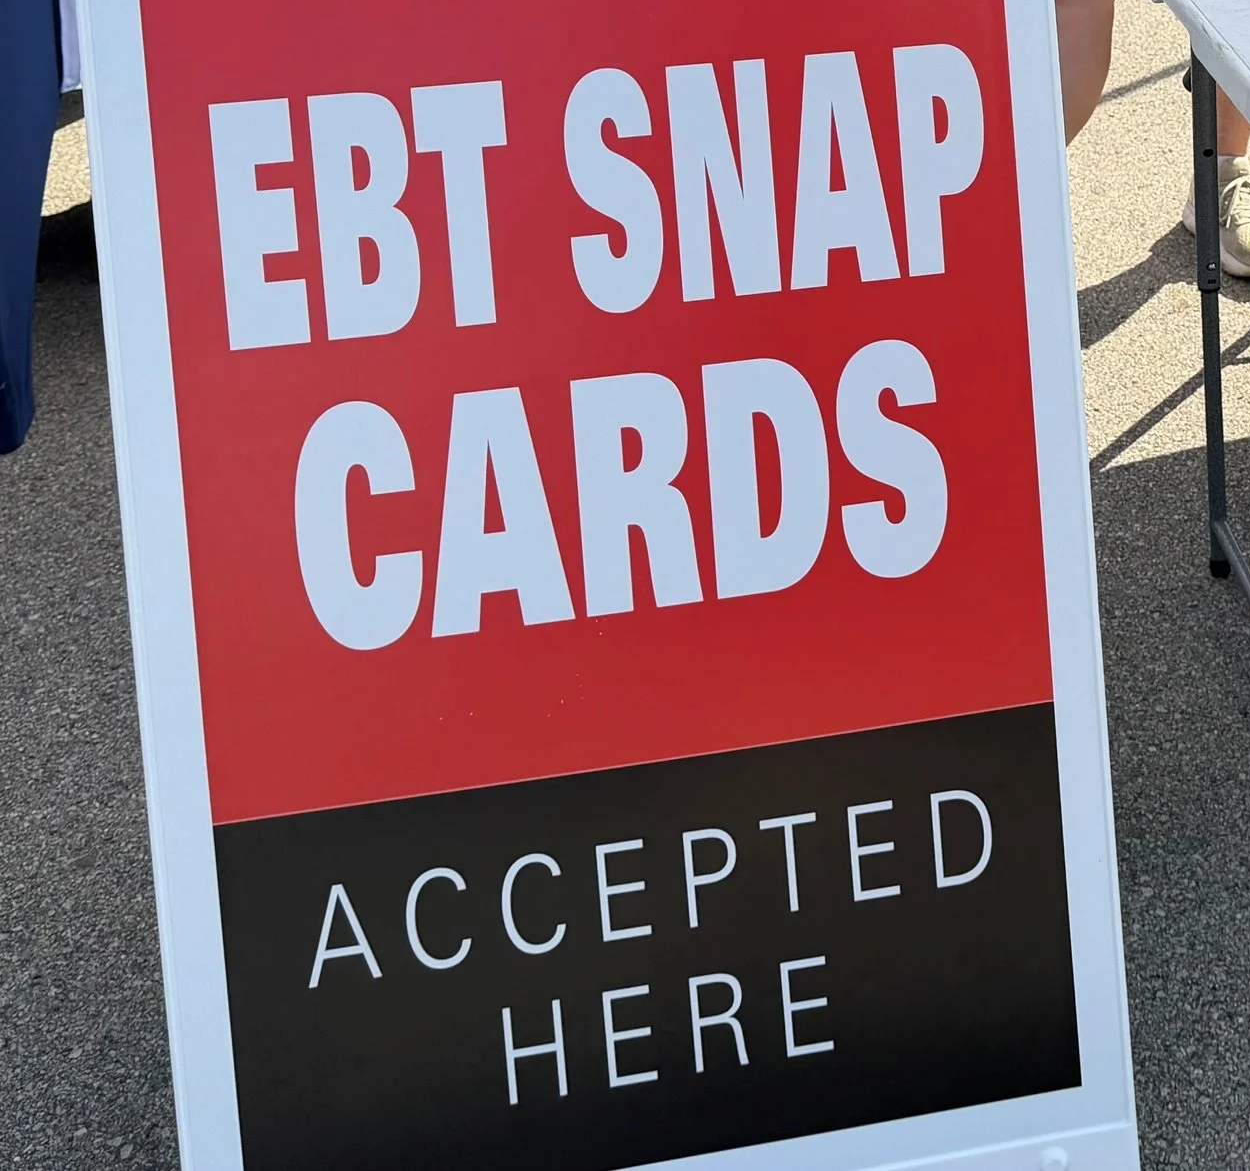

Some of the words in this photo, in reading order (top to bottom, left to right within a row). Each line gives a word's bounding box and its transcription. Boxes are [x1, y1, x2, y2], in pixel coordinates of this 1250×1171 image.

[208, 81, 507, 350] EBT
[564, 44, 984, 313] SNAP
[295, 340, 947, 650] CARDS
[309, 790, 993, 989] ACCEPTED
[502, 956, 835, 1105] HERE
